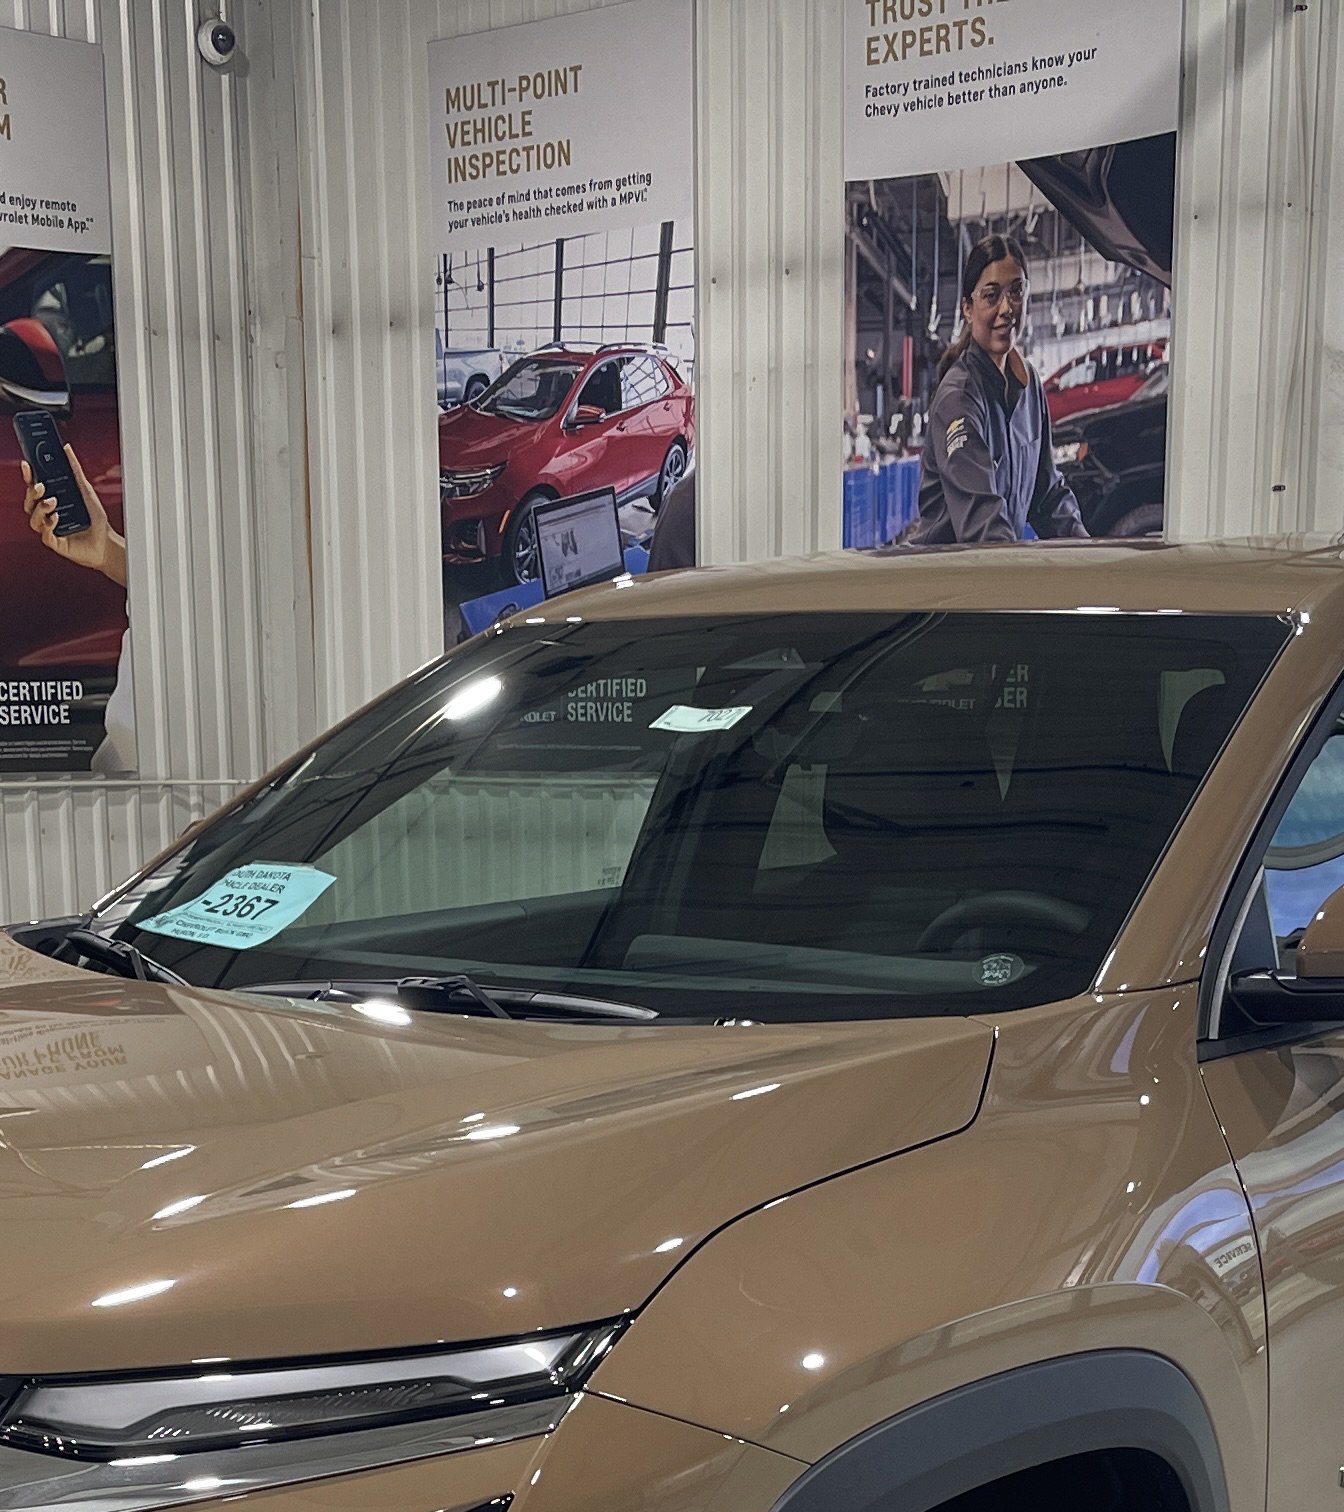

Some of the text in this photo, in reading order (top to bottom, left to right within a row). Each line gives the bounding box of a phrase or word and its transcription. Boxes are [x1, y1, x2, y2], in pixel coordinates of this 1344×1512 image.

[866, 16, 994, 66] EXPERTS.
[445, 64, 582, 114] MULTI-POINT
[865, 48, 1097, 98] Factory trained technicians know your
[865, 75, 1068, 117] Chevy vehicle better than anyone.
[445, 109, 533, 149] VEHICLE
[447, 139, 571, 184] INSPECTION
[9, 194, 37, 210] enjoy
[39, 199, 77, 213] remote
[448, 172, 652, 213] The peace of mind that comes from getting
[31, 214, 65, 229] Mobile
[448, 215, 468, 233] your
[471, 210, 510, 227] vehicle's
[512, 205, 542, 221] health
[544, 201, 584, 217] checked
[586, 195, 608, 212] with
[610, 196, 617, 207] a
[567, 702, 633, 723] SERVICE
